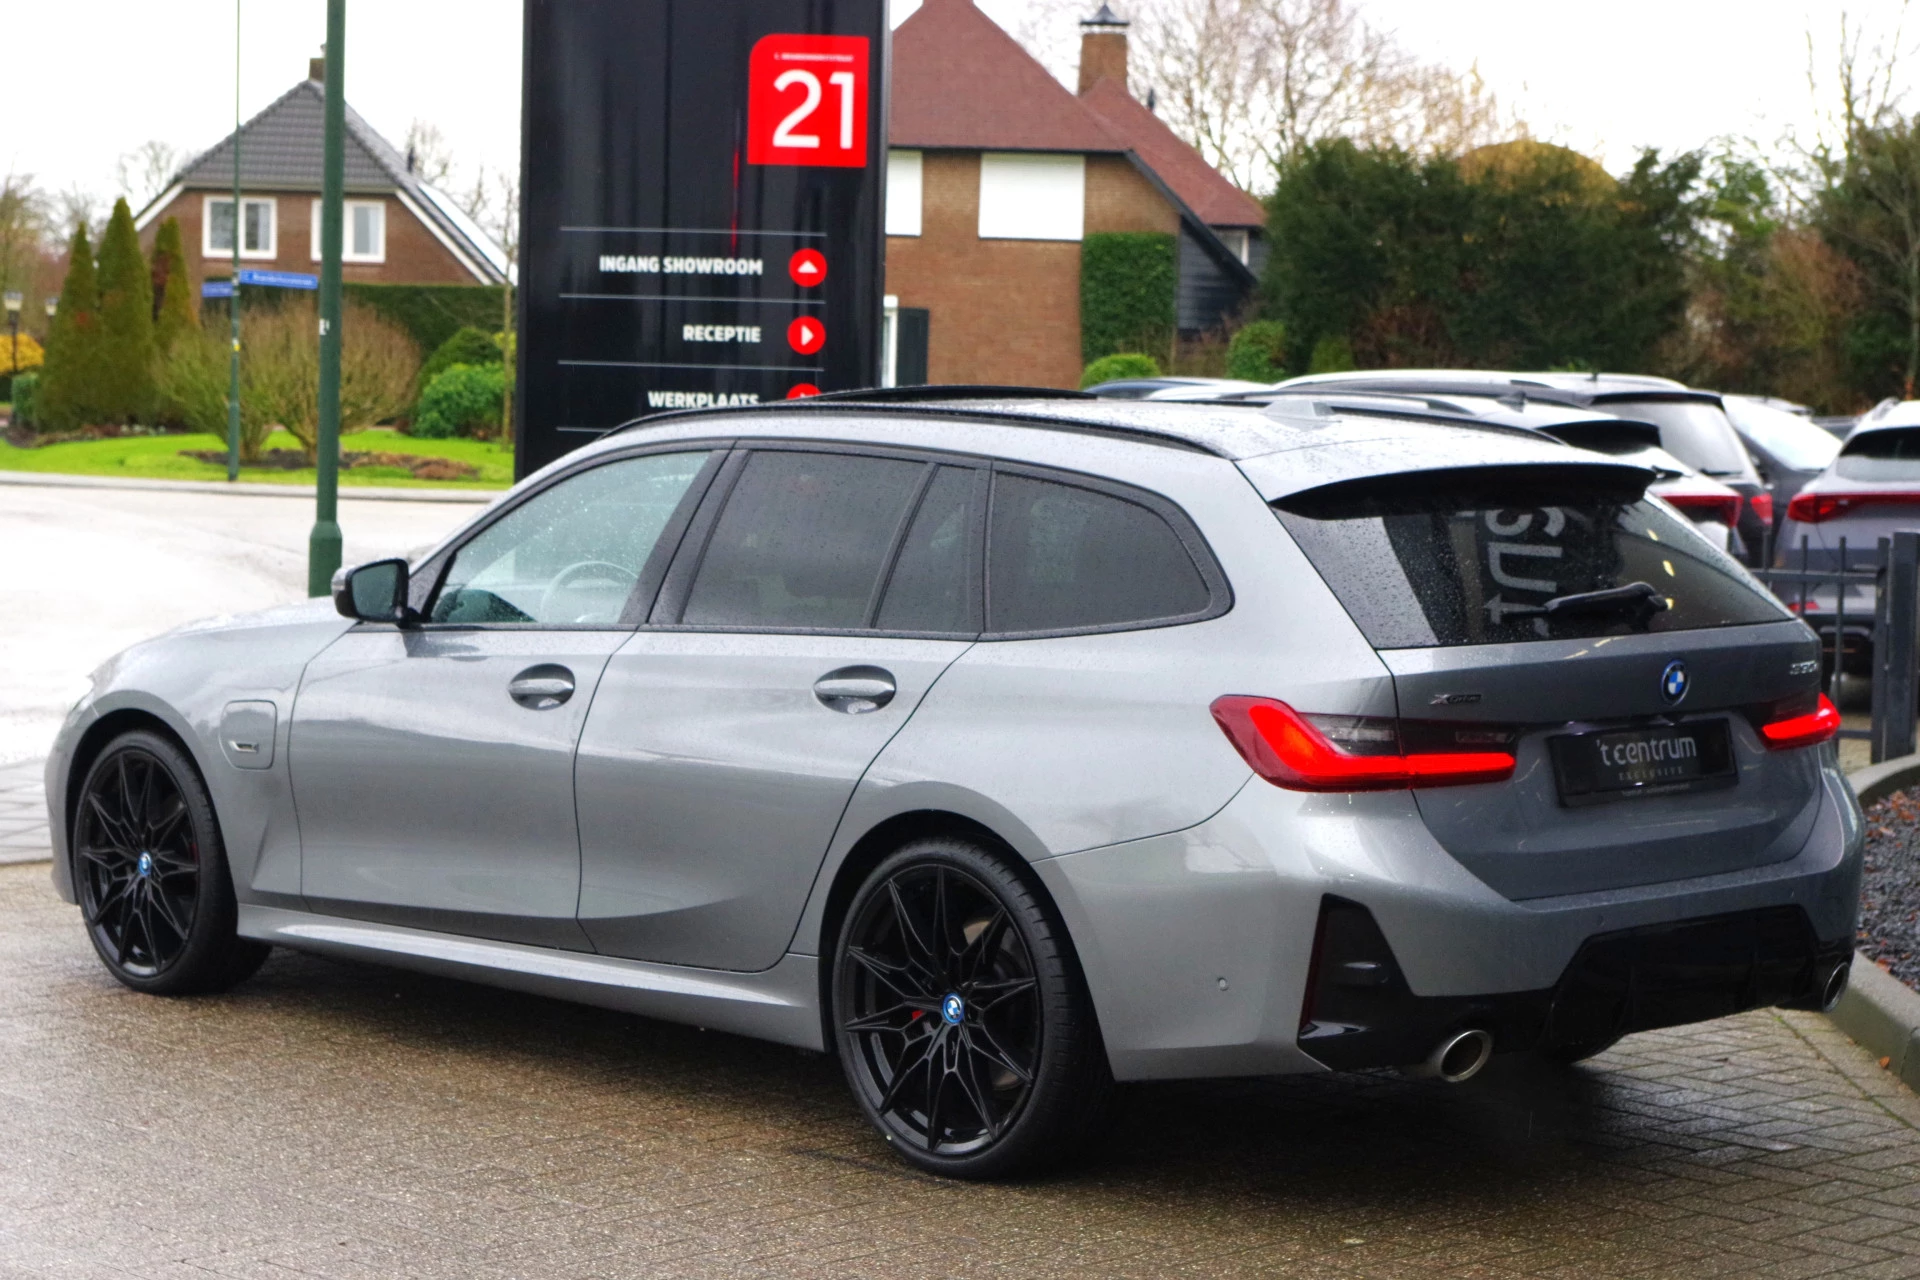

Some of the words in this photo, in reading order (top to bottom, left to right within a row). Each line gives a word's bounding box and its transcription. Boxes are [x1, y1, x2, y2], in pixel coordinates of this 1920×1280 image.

[772, 69, 855, 150] 21
[599, 254, 661, 273] INGANG
[662, 256, 764, 276] SHOWROOM
[682, 324, 762, 343] RECEPTIE
[647, 390, 760, 409] WERKPLAATS
[1613, 736, 1697, 765] centrum
